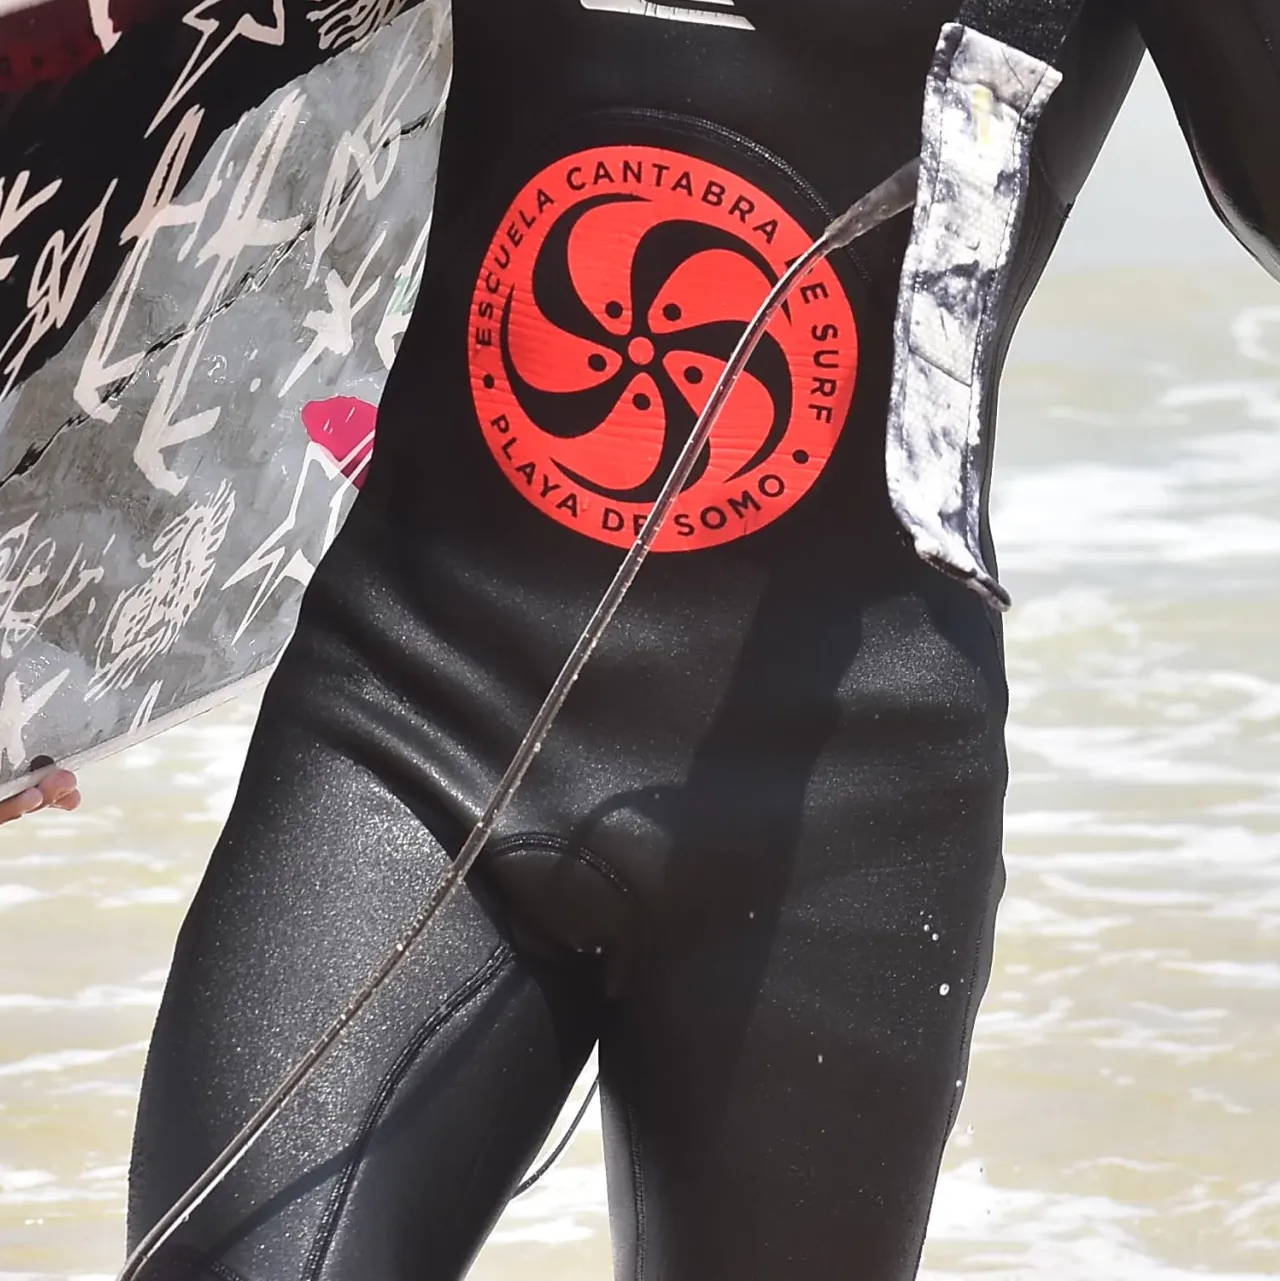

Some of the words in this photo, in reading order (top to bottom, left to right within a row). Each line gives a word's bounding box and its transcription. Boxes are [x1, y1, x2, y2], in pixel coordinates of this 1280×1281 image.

[476, 188, 555, 346] ESCUELA
[566, 160, 778, 244] CANTABRA
[808, 323, 839, 425] SURF
[491, 414, 577, 518] PLAYA
[674, 473, 785, 536] SOMO
